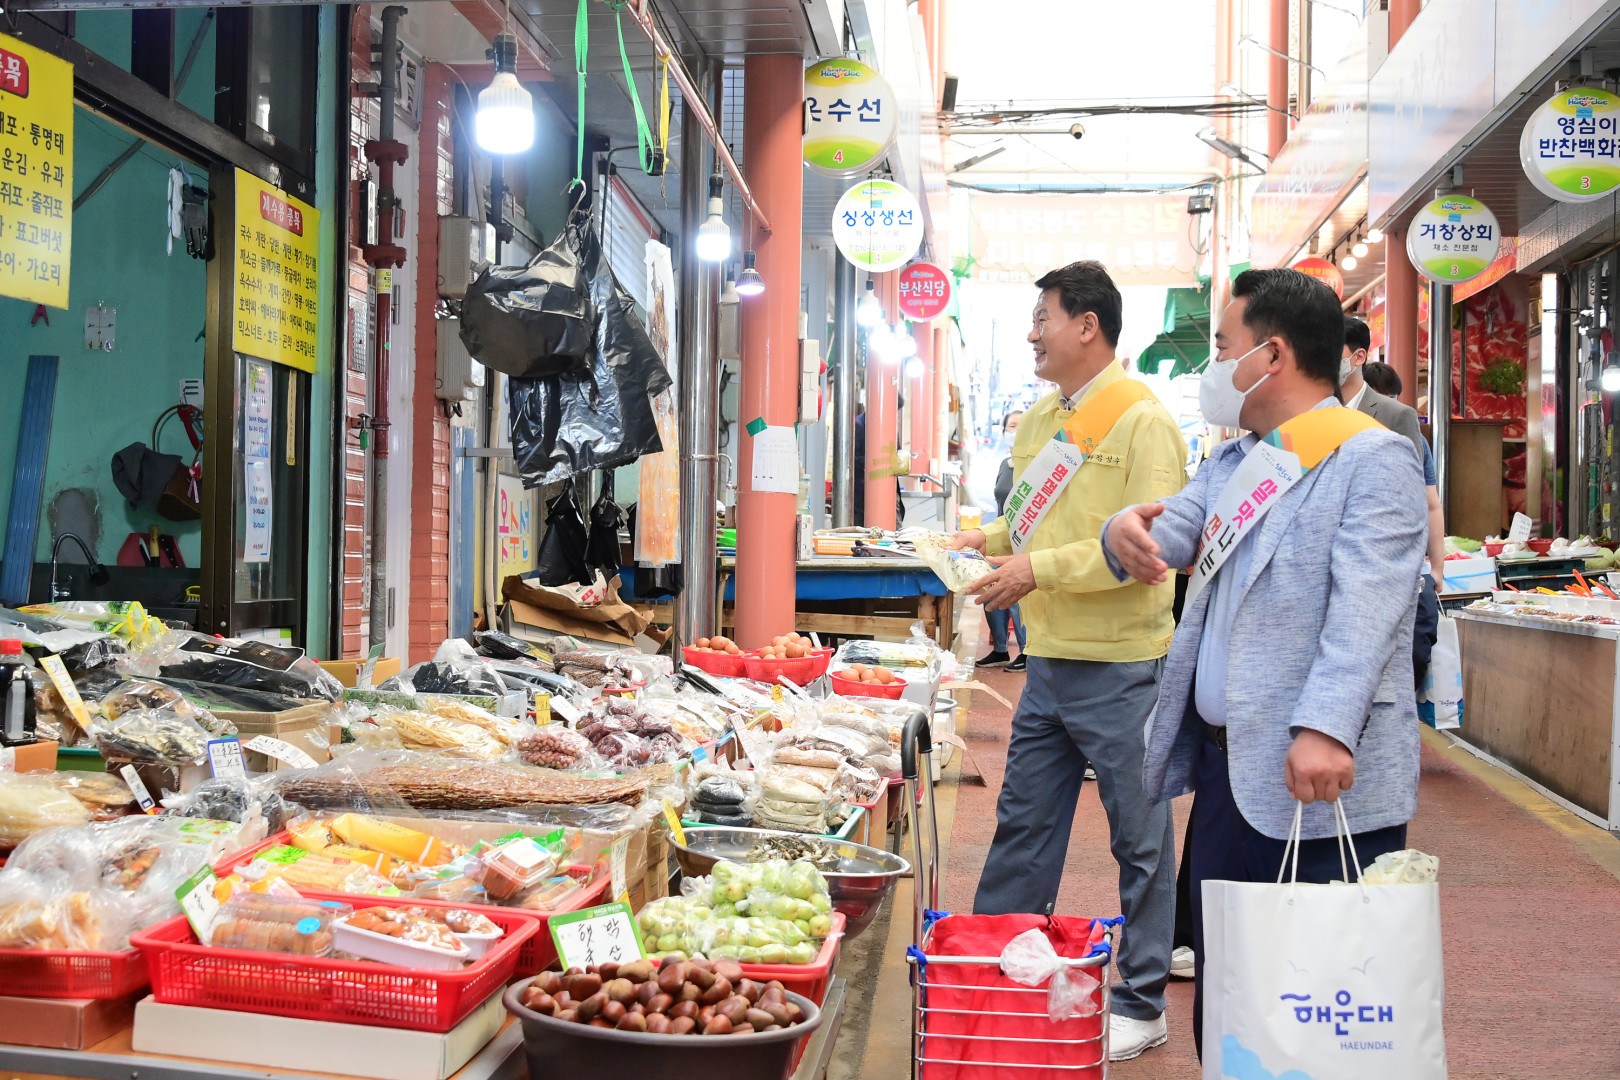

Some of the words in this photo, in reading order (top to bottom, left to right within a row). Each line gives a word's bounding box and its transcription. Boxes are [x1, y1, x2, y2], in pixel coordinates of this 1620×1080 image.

[1556, 116, 1617, 136] 영심이
[832, 149, 844, 164] 4
[1539, 138, 1620, 159] 반찬백화
[40, 160, 65, 189] 유과
[1580, 175, 1591, 190] 3
[31, 190, 64, 219] 줄쥐포
[286, 207, 301, 231] 품목
[842, 207, 914, 228] 싱싱생선
[16, 220, 62, 254] 표고버섯
[240, 224, 252, 243] 국수
[1420, 223, 1493, 242] 거창상회
[873, 252, 882, 263] 4
[1432, 243, 1449, 252] 채소
[1453, 243, 1478, 252] 전문점
[26, 257, 61, 287] 가오리
[1450, 265, 1459, 276] 3
[240, 272, 263, 295] 옥수수차
[899, 280, 946, 298] 부산식당
[919, 306, 926, 317] 1
[238, 320, 263, 341] 믹스너트
[267, 328, 279, 347] 호두
[1279, 989, 1394, 1036] 해운대
[1339, 1040, 1394, 1051] HAEUNDAE
